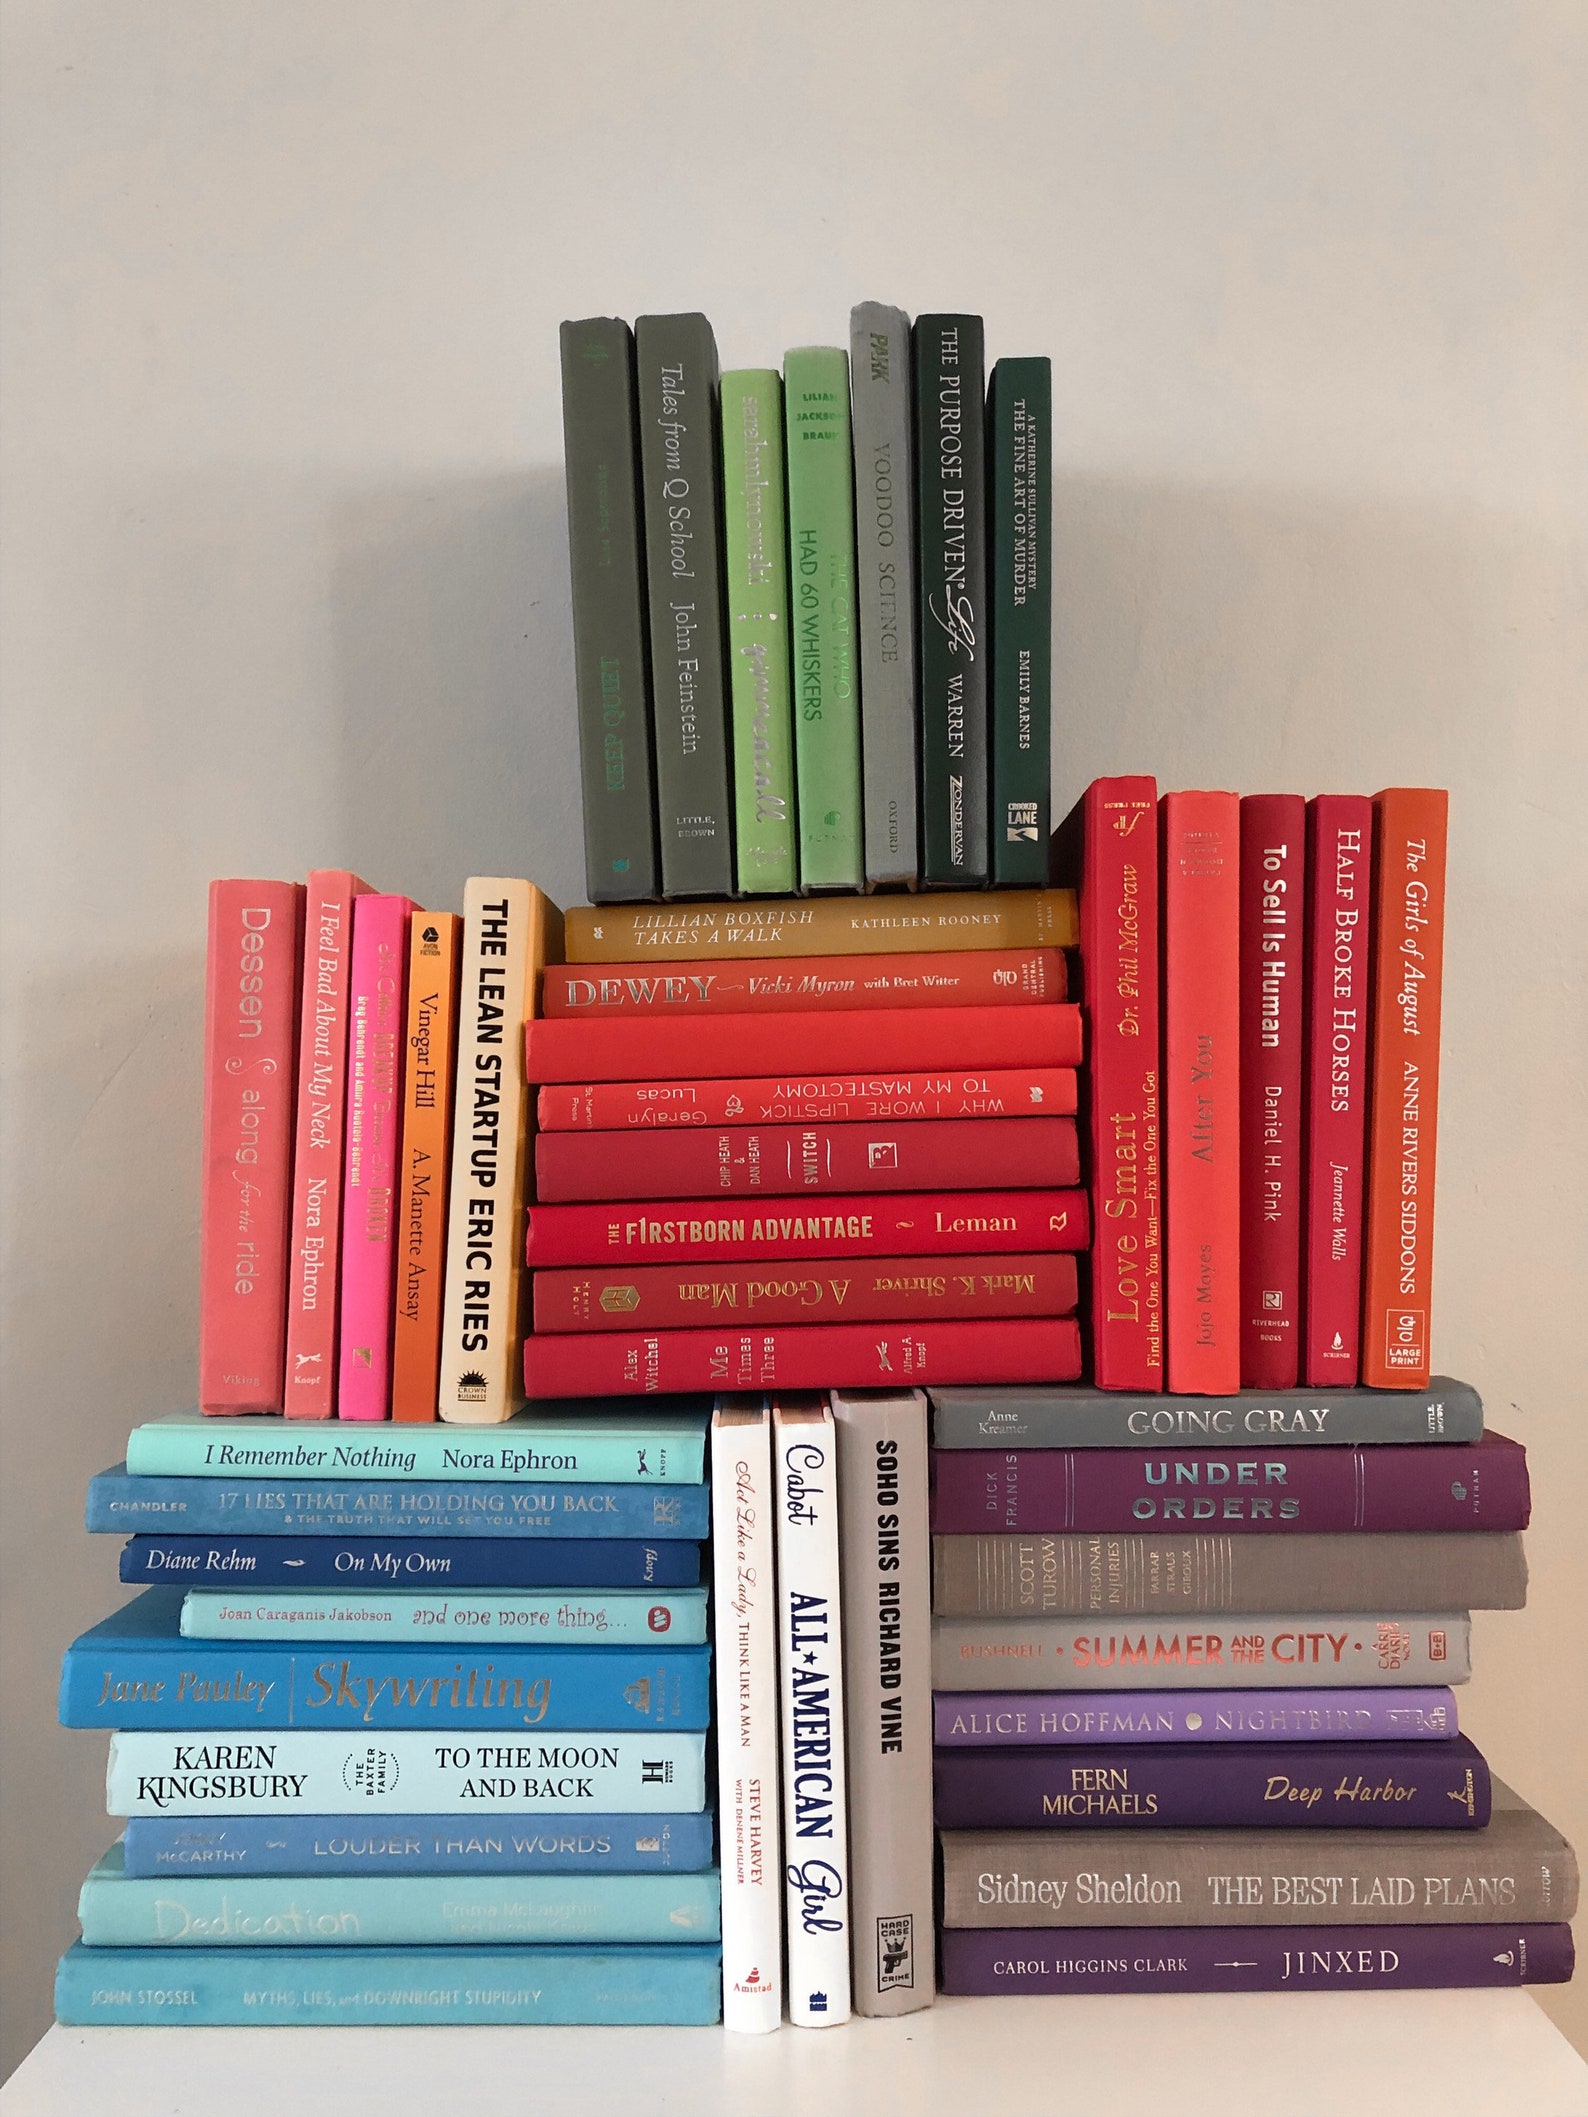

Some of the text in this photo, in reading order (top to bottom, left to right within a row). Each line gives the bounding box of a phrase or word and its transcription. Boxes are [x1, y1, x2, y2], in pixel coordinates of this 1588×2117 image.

[657, 363, 696, 579] Tales from Q School
[1013, 398, 1027, 607] THE FINE ART OF MURDER
[874, 442, 898, 664] VOODOO SCIENCE
[799, 530, 823, 722] HAD 60 WHISKERS
[670, 602, 701, 755] John Feinstein
[947, 673, 964, 758] WARREN
[1018, 650, 1031, 750] EMILY BARNES
[950, 775, 964, 866] ZONDERVAN
[1007, 811, 1038, 825] LANE
[632, 910, 814, 929] LILLIAN BOXFISH
[851, 913, 1002, 929] KATHLEEN ROONEY
[1261, 844, 1287, 1047] To Sell Is Human
[238, 907, 272, 1038] Dessen
[747, 974, 856, 998] Vicki Myron
[863, 974, 961, 989] with Bret Witter
[1330, 828, 1361, 1112] HALF BROKE HORSES
[564, 975, 718, 1007] DEWEY
[410, 992, 439, 1108] Vinegar Hill
[470, 899, 509, 1188] THE LEAN STARTUP
[636, 1087, 697, 1103] Lucas
[627, 1106, 708, 1127] Geralyn
[718, 1135, 732, 1187] CHIP HEATH
[748, 1135, 761, 1185] DAN HEATH
[803, 1131, 819, 1185] SWITCH
[1400, 1061, 1419, 1295] ANNE RIVERS SIDDONS
[935, 1211, 1018, 1233] Leman
[1105, 1110, 1139, 1323] Love Smart
[1330, 1160, 1348, 1262] Jeannette Walls
[300, 1178, 328, 1311] Nora Ephron
[399, 1148, 431, 1321] A. Manette Ansay
[461, 1199, 495, 1352] ERIC RIES
[582, 1281, 591, 1320] HENRY
[678, 1278, 851, 1309] A Good Man
[1252, 1318, 1290, 1328] RIVERHEAD
[1260, 1334, 1282, 1342] BOOKS
[624, 1349, 638, 1382] Alex
[643, 1337, 659, 1392] Witchel
[709, 1345, 728, 1379] Me
[761, 1336, 775, 1383] Three
[916, 1341, 927, 1369] Knopf
[1389, 1347, 1421, 1357] LARGE
[1390, 1357, 1420, 1365] PRINT
[223, 1374, 260, 1387] Viking
[293, 1375, 322, 1385] Knopf
[978, 1422, 1028, 1435] Kreamer
[987, 1410, 1019, 1422] Anne
[1127, 1408, 1330, 1435] GOING GRAY
[441, 1448, 578, 1474] Nora Ephron
[659, 1448, 667, 1476] KNOPF
[1143, 1461, 1289, 1486] UNDER
[785, 1443, 825, 1526] Cabot
[985, 1471, 998, 1511] DICK
[1005, 1454, 1018, 1527] FRANCIS
[109, 1501, 188, 1513] CHANDLER
[876, 1440, 900, 1572] SOHO SINS
[1131, 1496, 1301, 1520] ORDERS
[145, 1548, 257, 1571] Diane Rehm
[333, 1551, 452, 1579] On My Own
[1018, 1542, 1035, 1606] SCOTT
[1042, 1537, 1057, 1611] TUROW
[1089, 1535, 1101, 1610] PERSONAL
[1107, 1540, 1120, 1605] INJURIES
[1149, 1550, 1160, 1595] FARRAR
[1165, 1551, 1176, 1593] STRAUS
[1183, 1550, 1193, 1595] GIROUX
[219, 1606, 393, 1624] Joan Caraganis Jakobson
[1072, 1633, 1225, 1668] SUMMER
[1270, 1632, 1349, 1664] CITY
[878, 1581, 903, 1755] RICHARD VINE
[97, 1670, 276, 1713] Jane Pauley
[305, 1658, 553, 1725] Skywriting
[950, 1710, 1175, 1735] ALICE HOFFMAN
[172, 1745, 277, 1770] KAREN
[355, 1762, 365, 1786] THE
[366, 1747, 376, 1796] BAXTER
[378, 1749, 388, 1794] FAMILY
[434, 1747, 620, 1769] TO THE MOON
[136, 1774, 309, 1808] KINGSBURY
[459, 1778, 594, 1798] AND BACK
[1071, 1768, 1129, 1791] FERN
[1042, 1793, 1159, 1816] MICHAELS
[313, 1834, 612, 1856] LOUDER THAN WORDS
[749, 1778, 763, 1886] STEVE HARVEY
[787, 1859, 844, 1936] Girl
[978, 1872, 1183, 1909] Sidney Sheldon
[151, 1895, 361, 1943] Dedication
[880, 1920, 911, 1930] HARD
[880, 1929, 910, 1938] CASE
[881, 1973, 911, 1983] CRIME
[1281, 1949, 1400, 1980] JINXED
[90, 1989, 198, 2006] JOHN STOSSEL
[733, 1981, 773, 1994] Amistad
